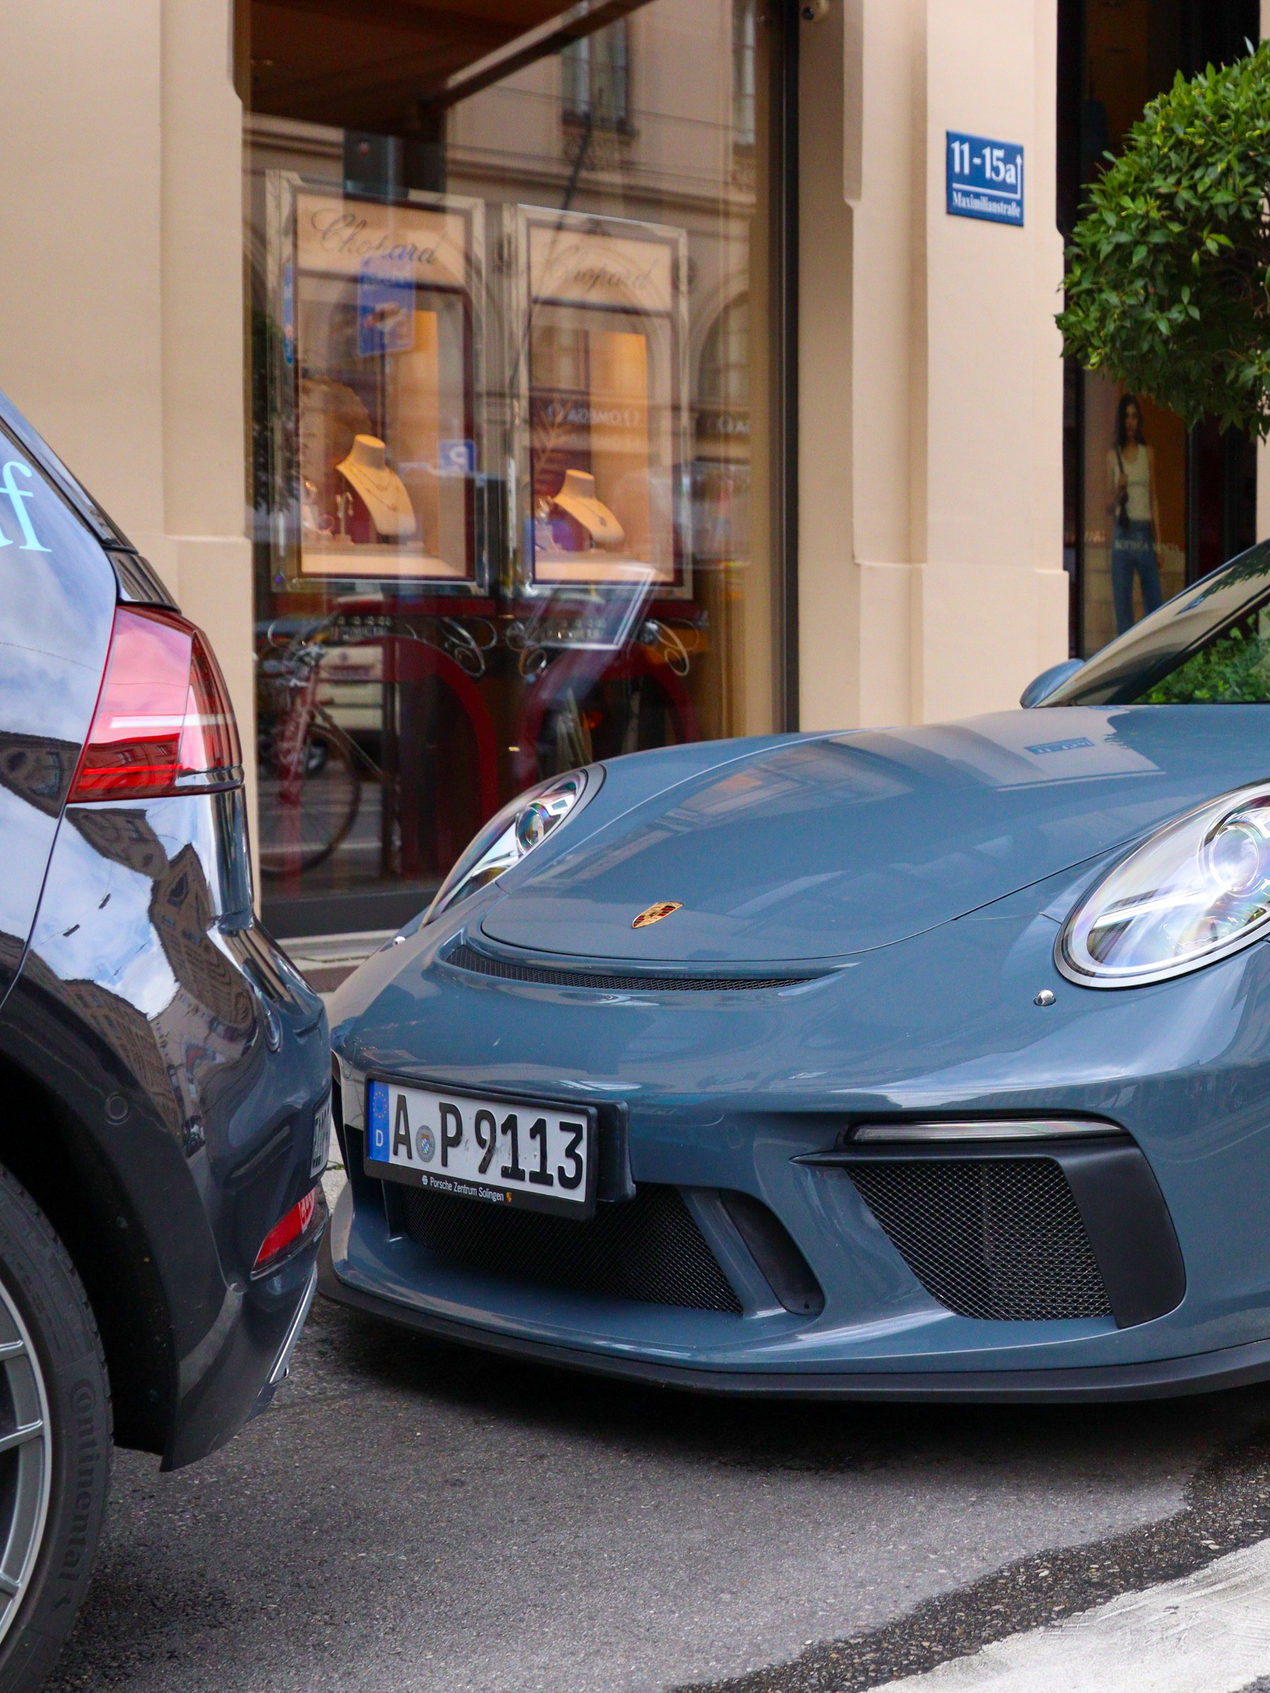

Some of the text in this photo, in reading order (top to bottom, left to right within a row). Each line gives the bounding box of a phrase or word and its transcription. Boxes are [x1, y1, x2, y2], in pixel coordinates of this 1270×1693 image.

[951, 140, 1016, 185] 11-15a
[953, 190, 1020, 218] Maximilianstraße
[0, 461, 52, 552] f
[375, 1129, 384, 1147] D
[392, 1094, 412, 1160] A
[439, 1101, 463, 1167] P
[474, 1109, 583, 1190] 9113
[430, 1176, 504, 1202] Porsche Zentrum Solingen
[58, 1377, 100, 1582] Continental
